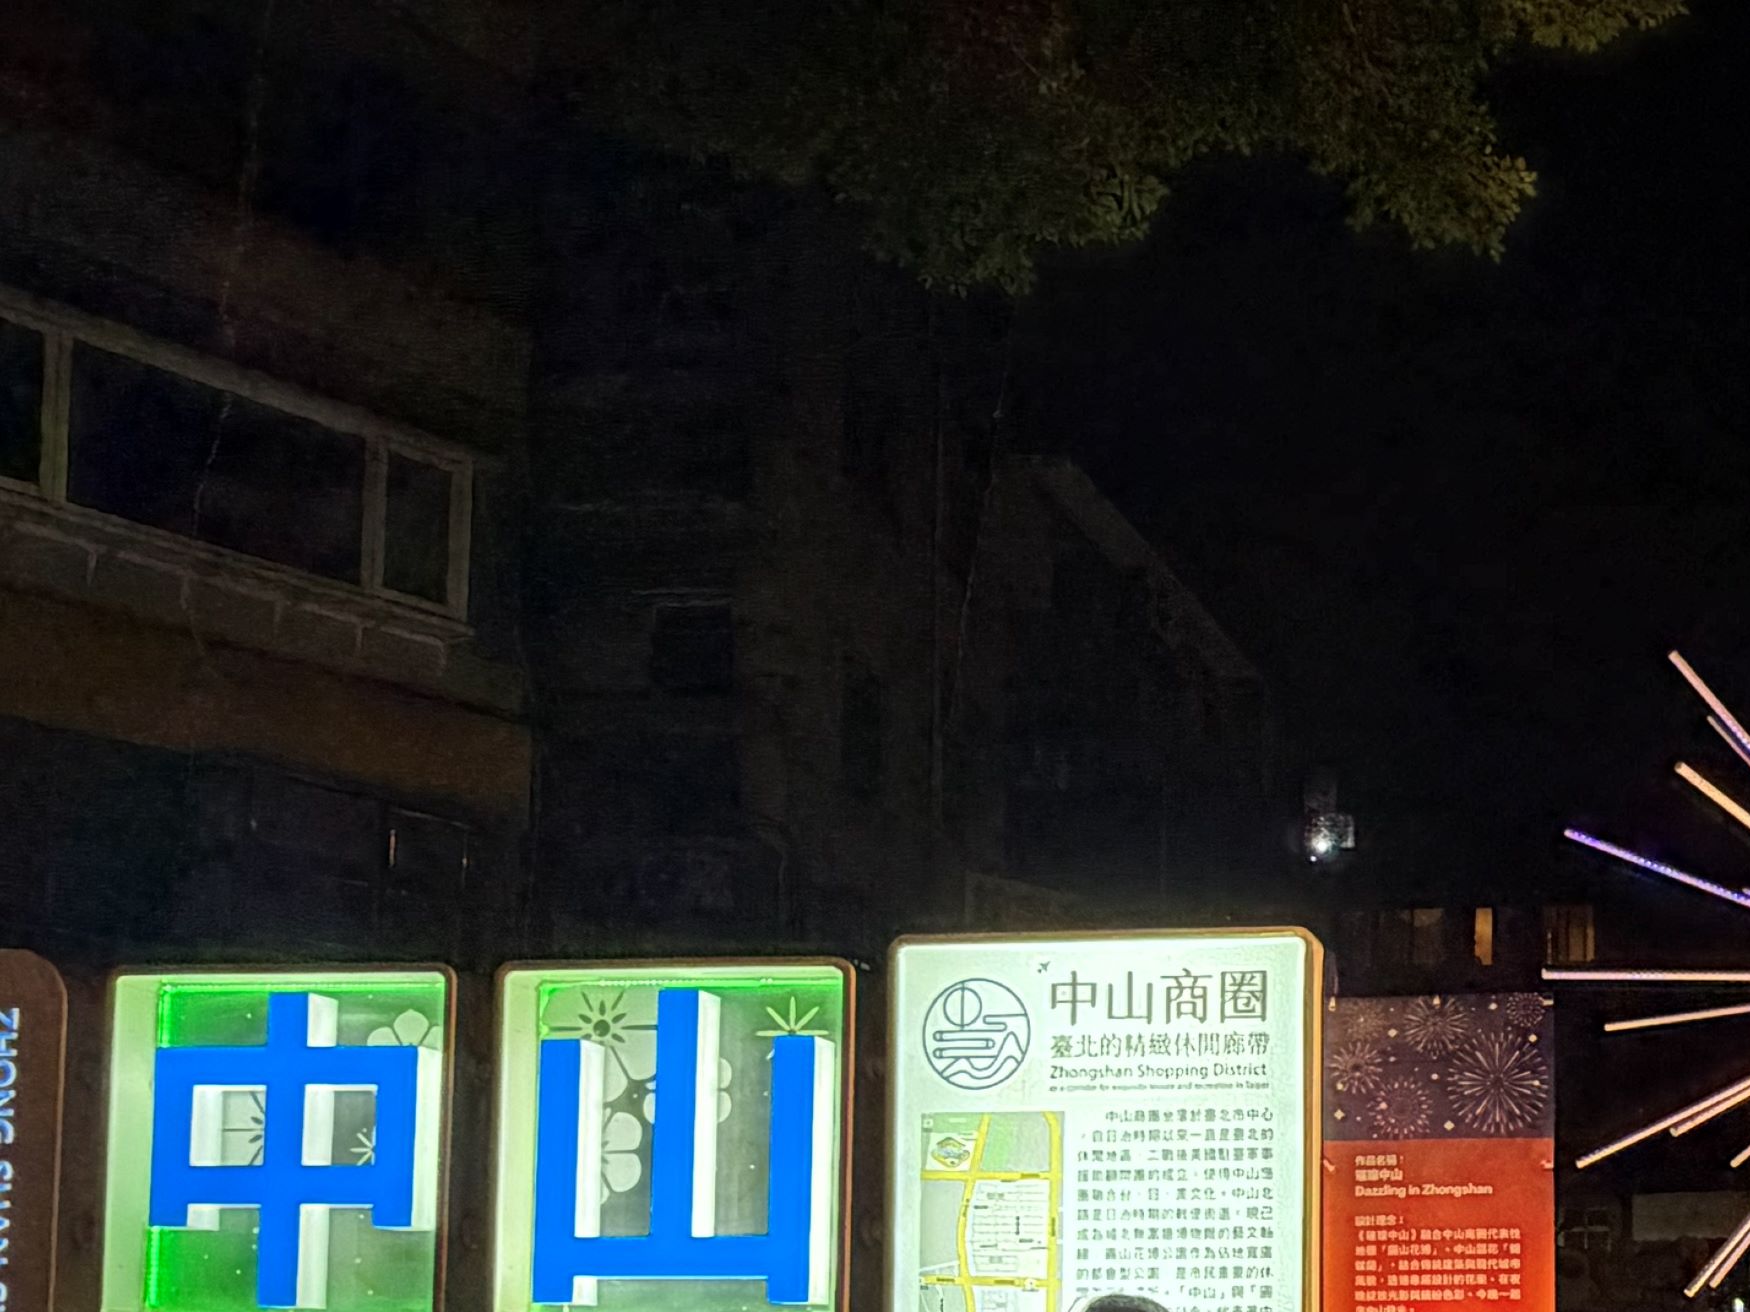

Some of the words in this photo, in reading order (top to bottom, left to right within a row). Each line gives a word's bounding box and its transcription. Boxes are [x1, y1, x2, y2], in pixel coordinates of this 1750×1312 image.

[1051, 966, 1267, 1026] 中山商圈
[1049, 1064, 1133, 1081] Zhongshan
[1137, 1063, 1208, 1080] Shopping
[1213, 1061, 1267, 1077] District
[1355, 1185, 1406, 1198] Dazzling
[1408, 1184, 1420, 1195] in
[1422, 1183, 1493, 1197] Zhongshan
